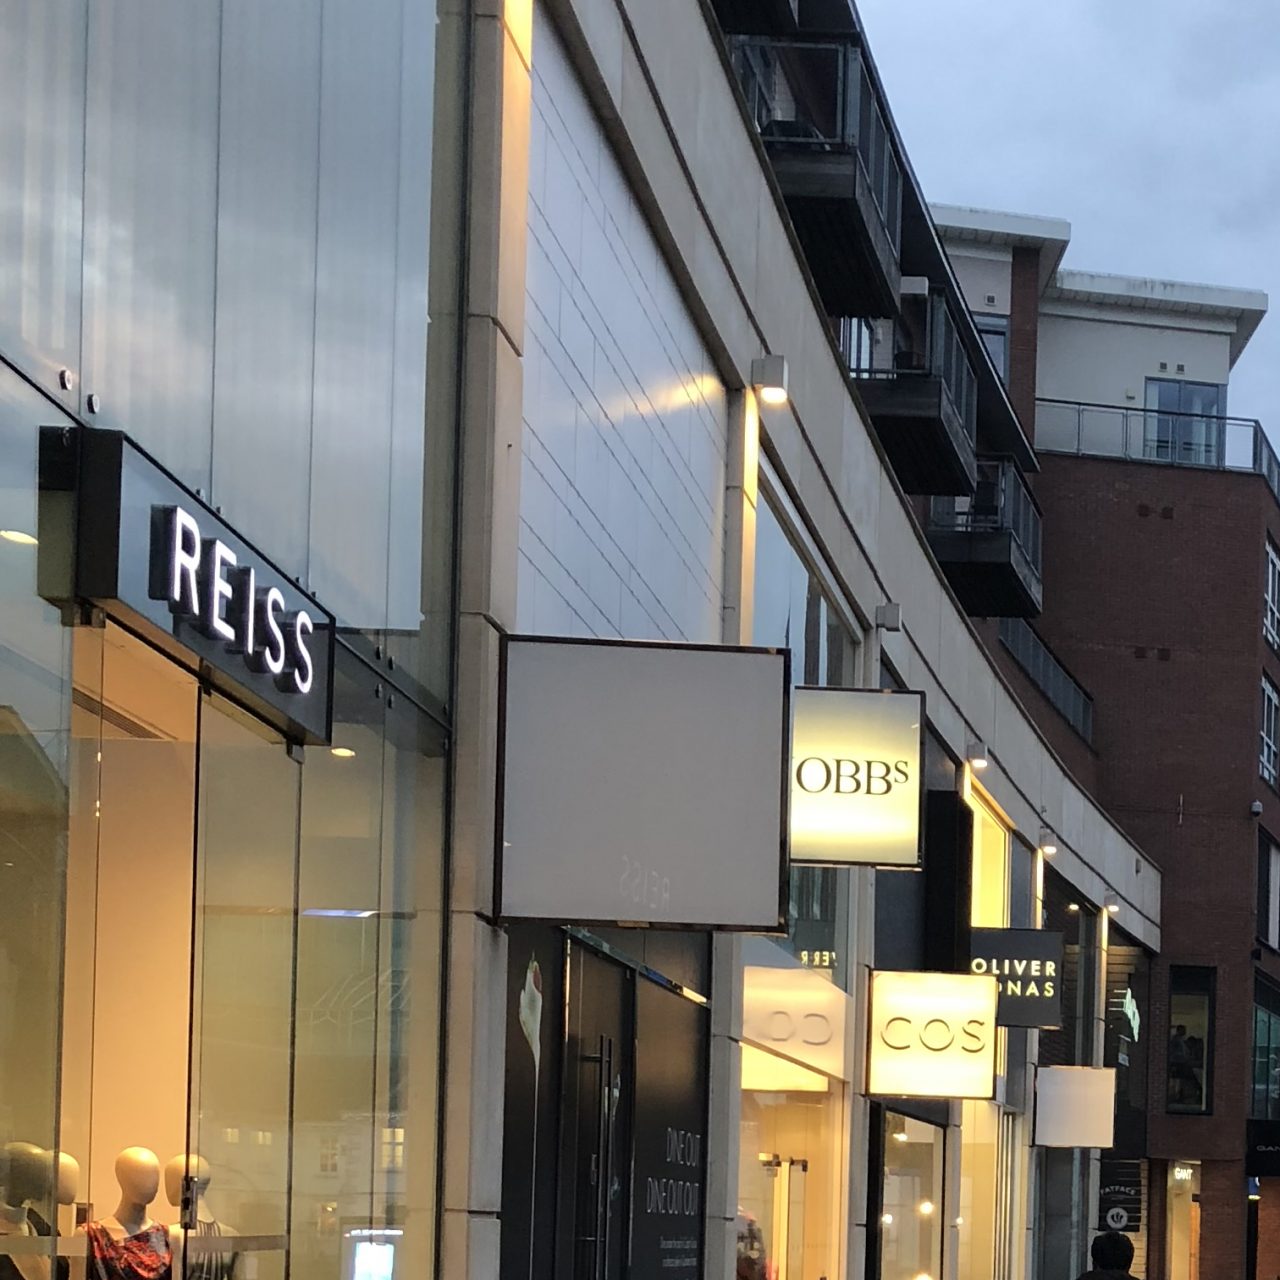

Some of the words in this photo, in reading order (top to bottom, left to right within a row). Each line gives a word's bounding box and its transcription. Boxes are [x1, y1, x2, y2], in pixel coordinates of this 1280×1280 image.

[168, 505, 314, 695] REISS
[795, 756, 909, 796] OBBS
[971, 957, 1056, 977] OLIVER
[998, 980, 1055, 997] NAS
[880, 1016, 987, 1053] COS
